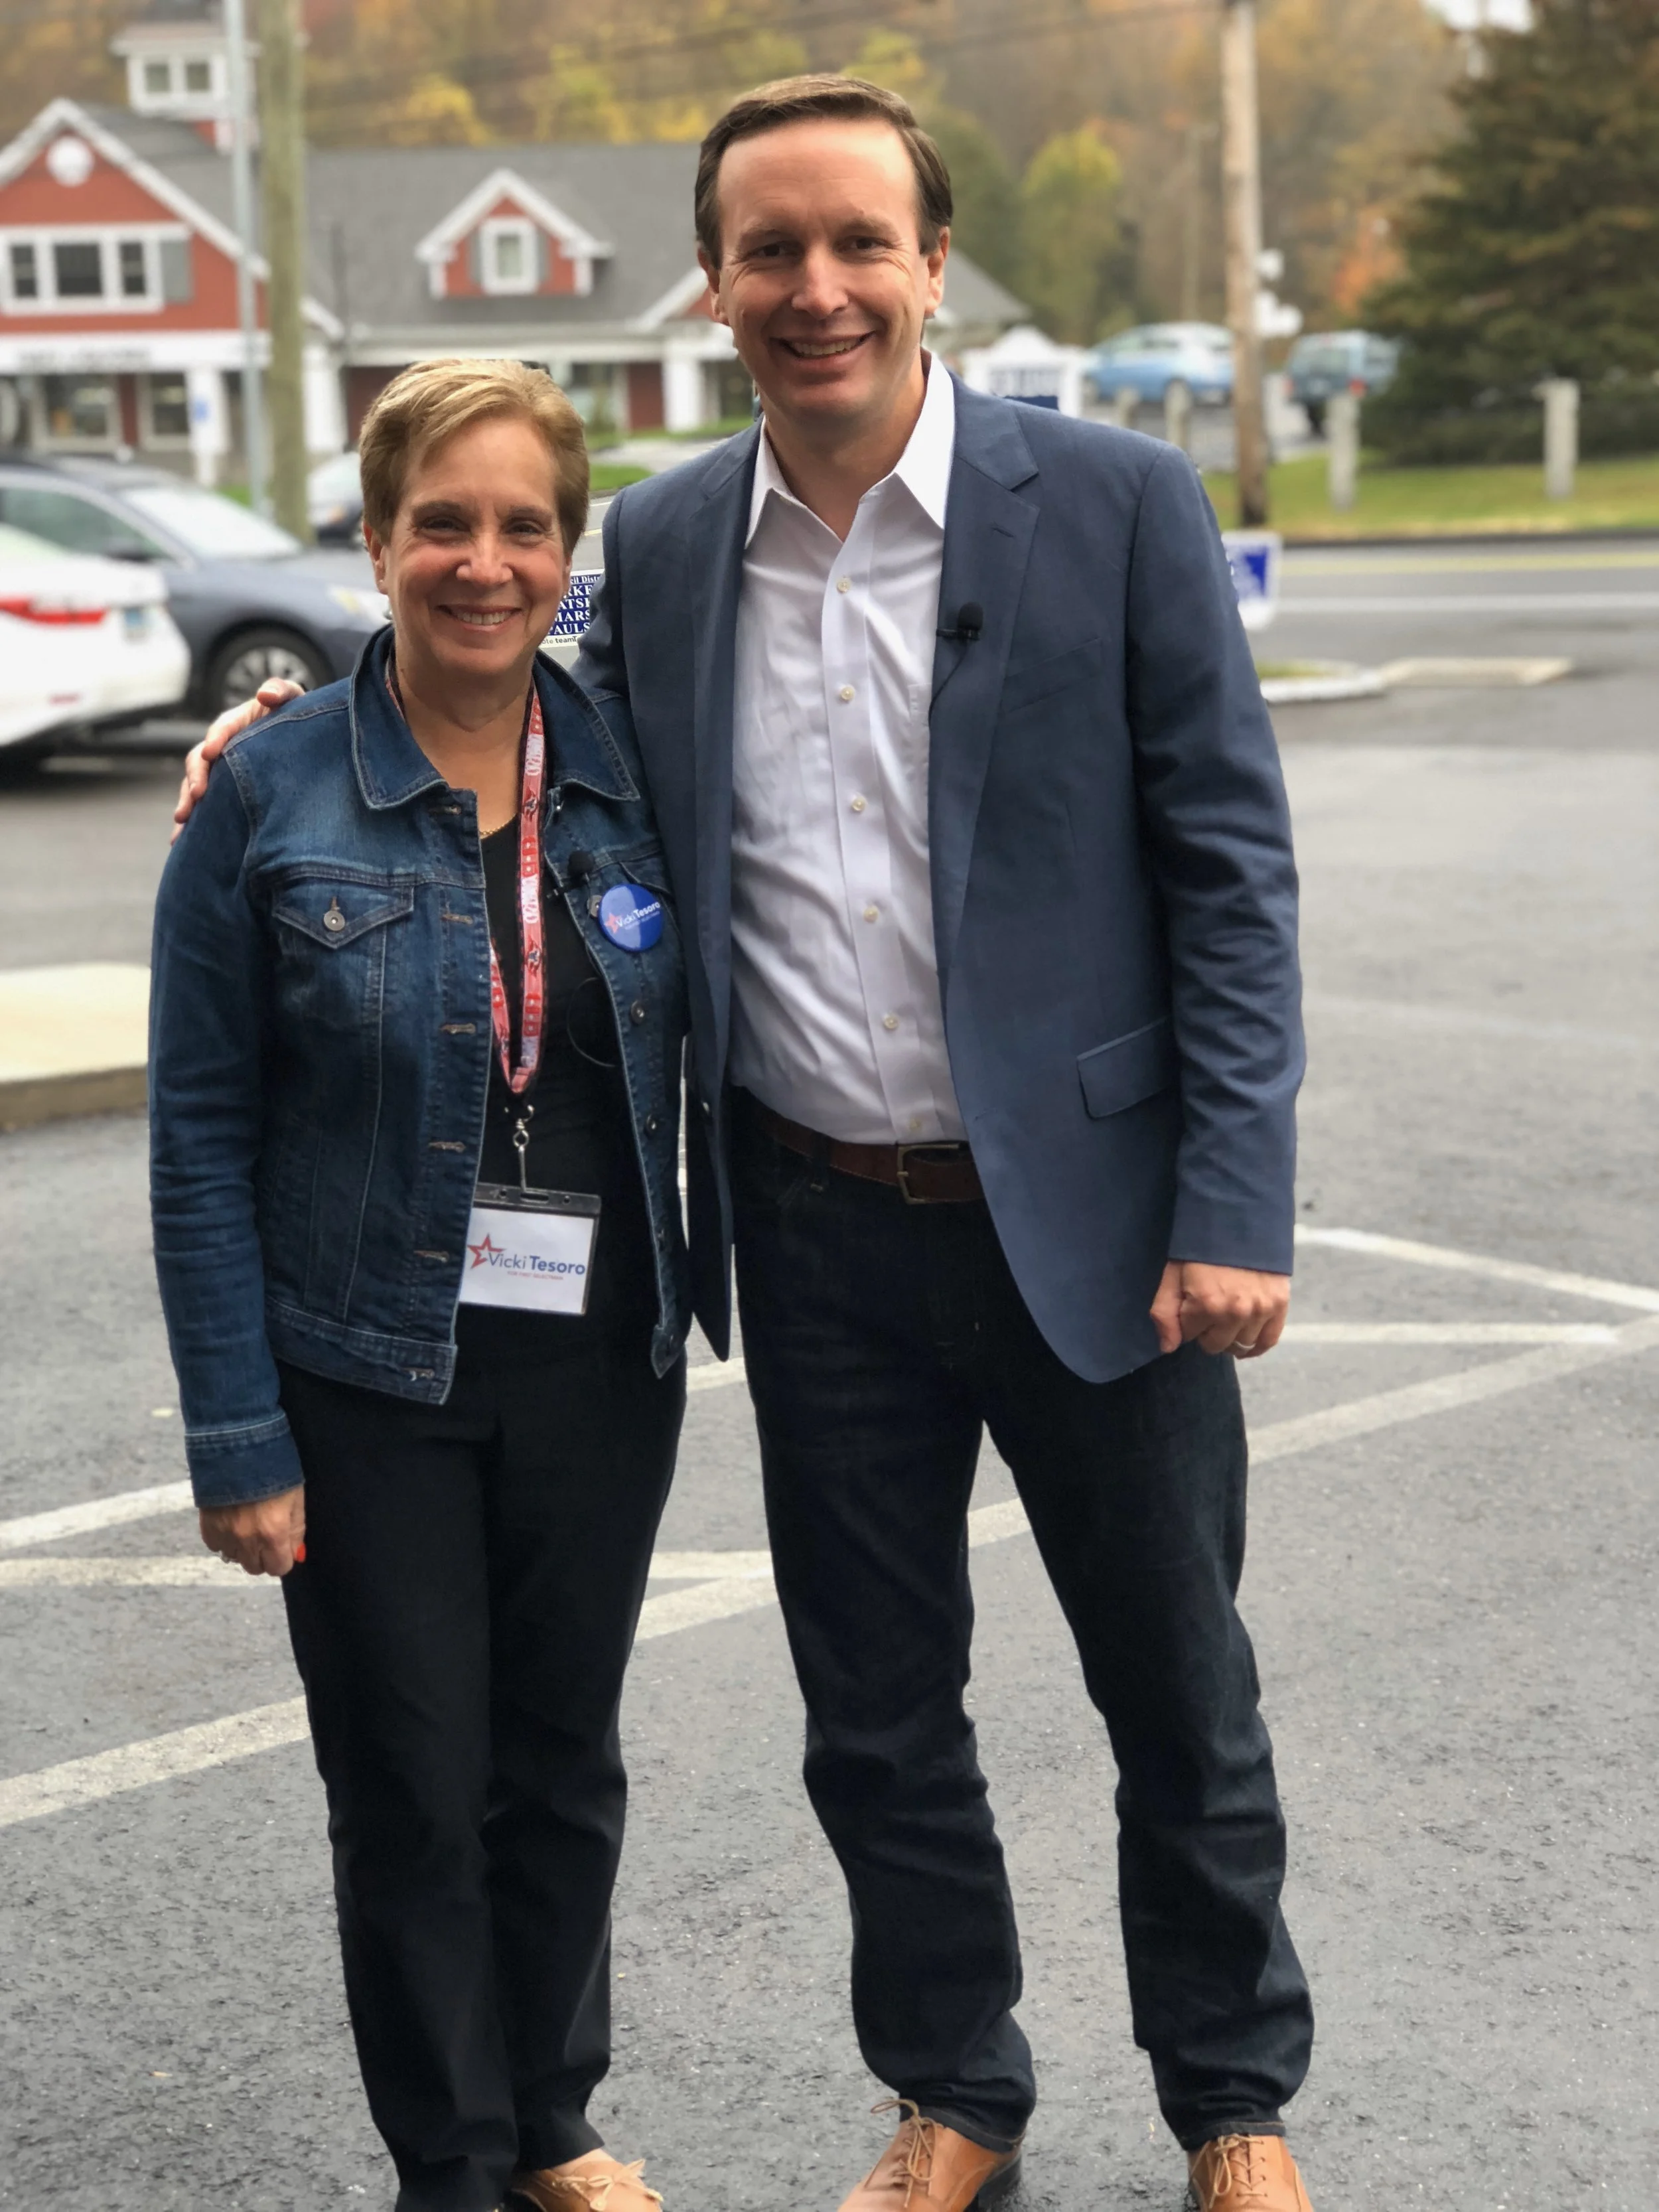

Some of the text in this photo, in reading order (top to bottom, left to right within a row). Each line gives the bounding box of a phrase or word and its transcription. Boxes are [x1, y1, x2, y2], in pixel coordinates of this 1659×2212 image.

[633, 901, 661, 919] Tesoro
[488, 1252, 586, 1275] Vicki Tesoro
